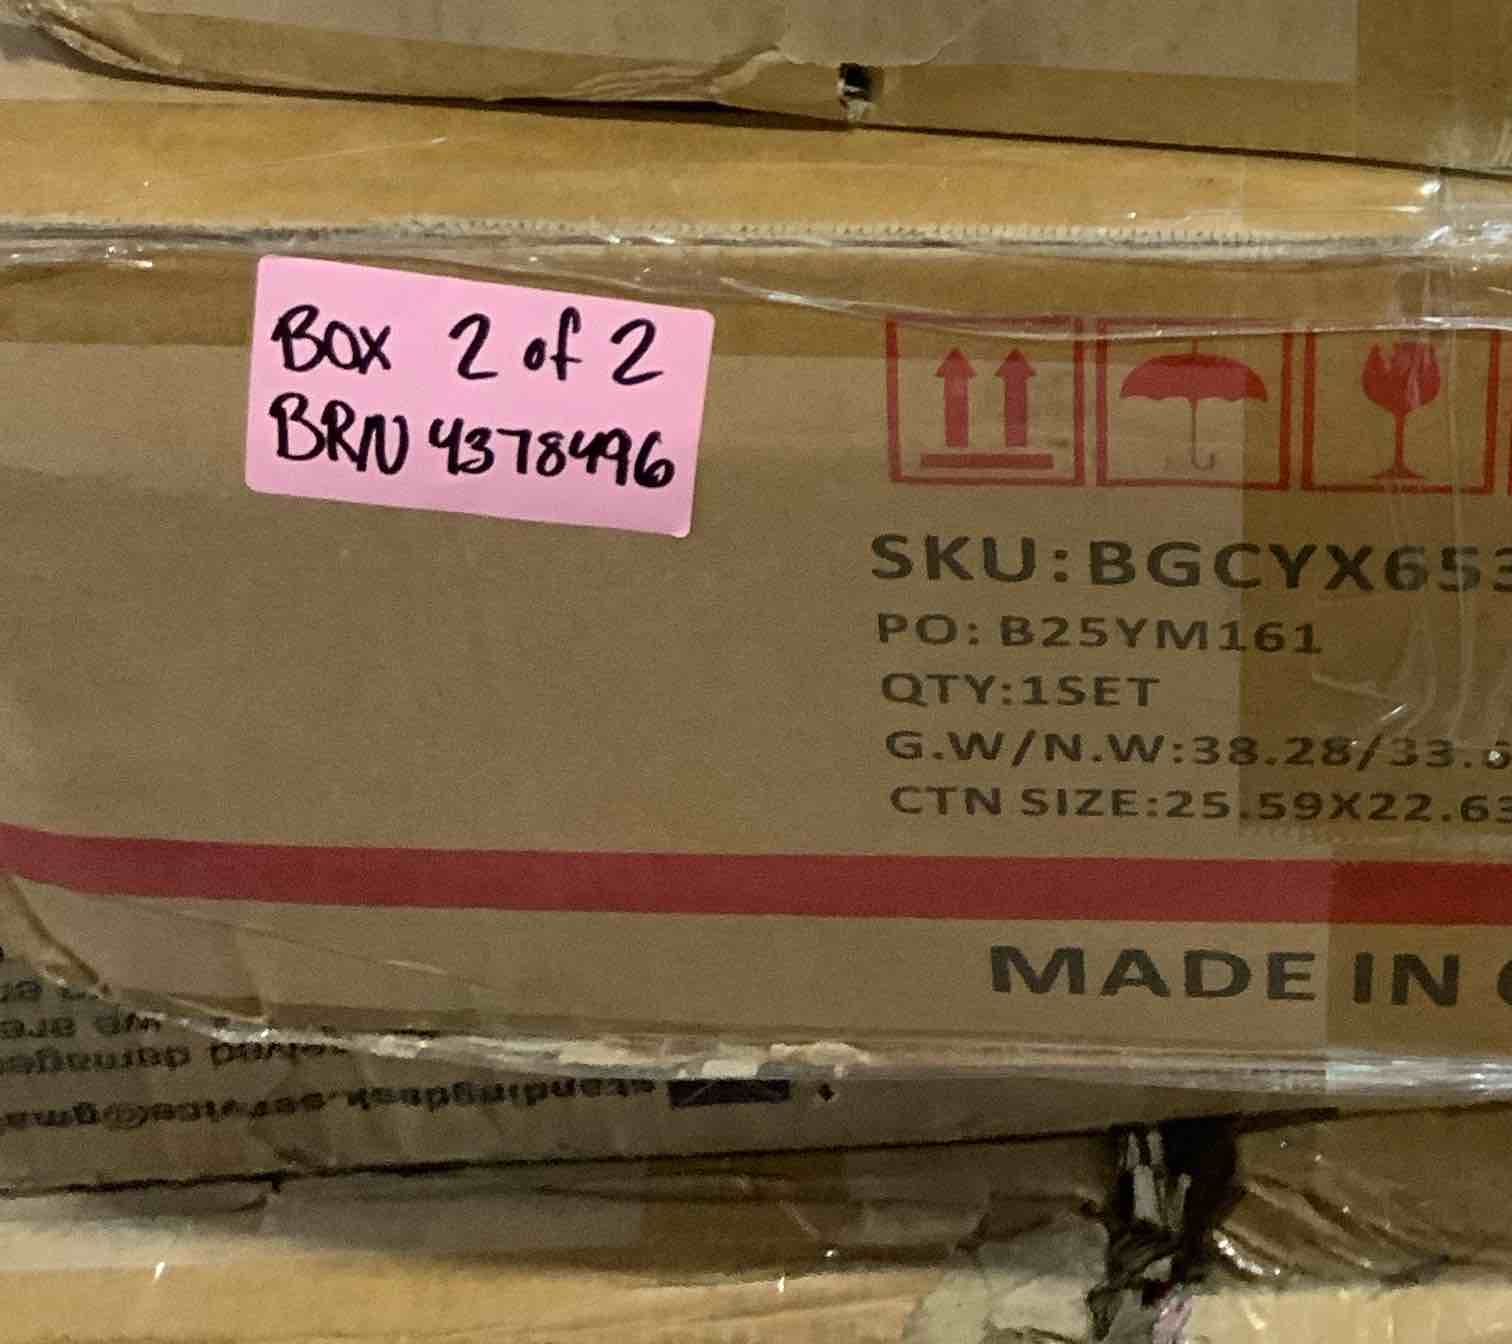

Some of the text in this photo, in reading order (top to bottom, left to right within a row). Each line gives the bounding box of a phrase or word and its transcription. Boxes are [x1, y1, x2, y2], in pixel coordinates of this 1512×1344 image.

[448, 313, 498, 380] 2
[523, 306, 582, 381] of
[610, 318, 664, 386] 2
[268, 392, 676, 489] BRN 4378496
[876, 613, 1323, 655] PO: B25YM161
[880, 672, 1161, 708] QTY:1SET
[889, 785, 1001, 816] CTN
[989, 944, 1317, 1003] MADE
[1352, 951, 1461, 1010] IN
